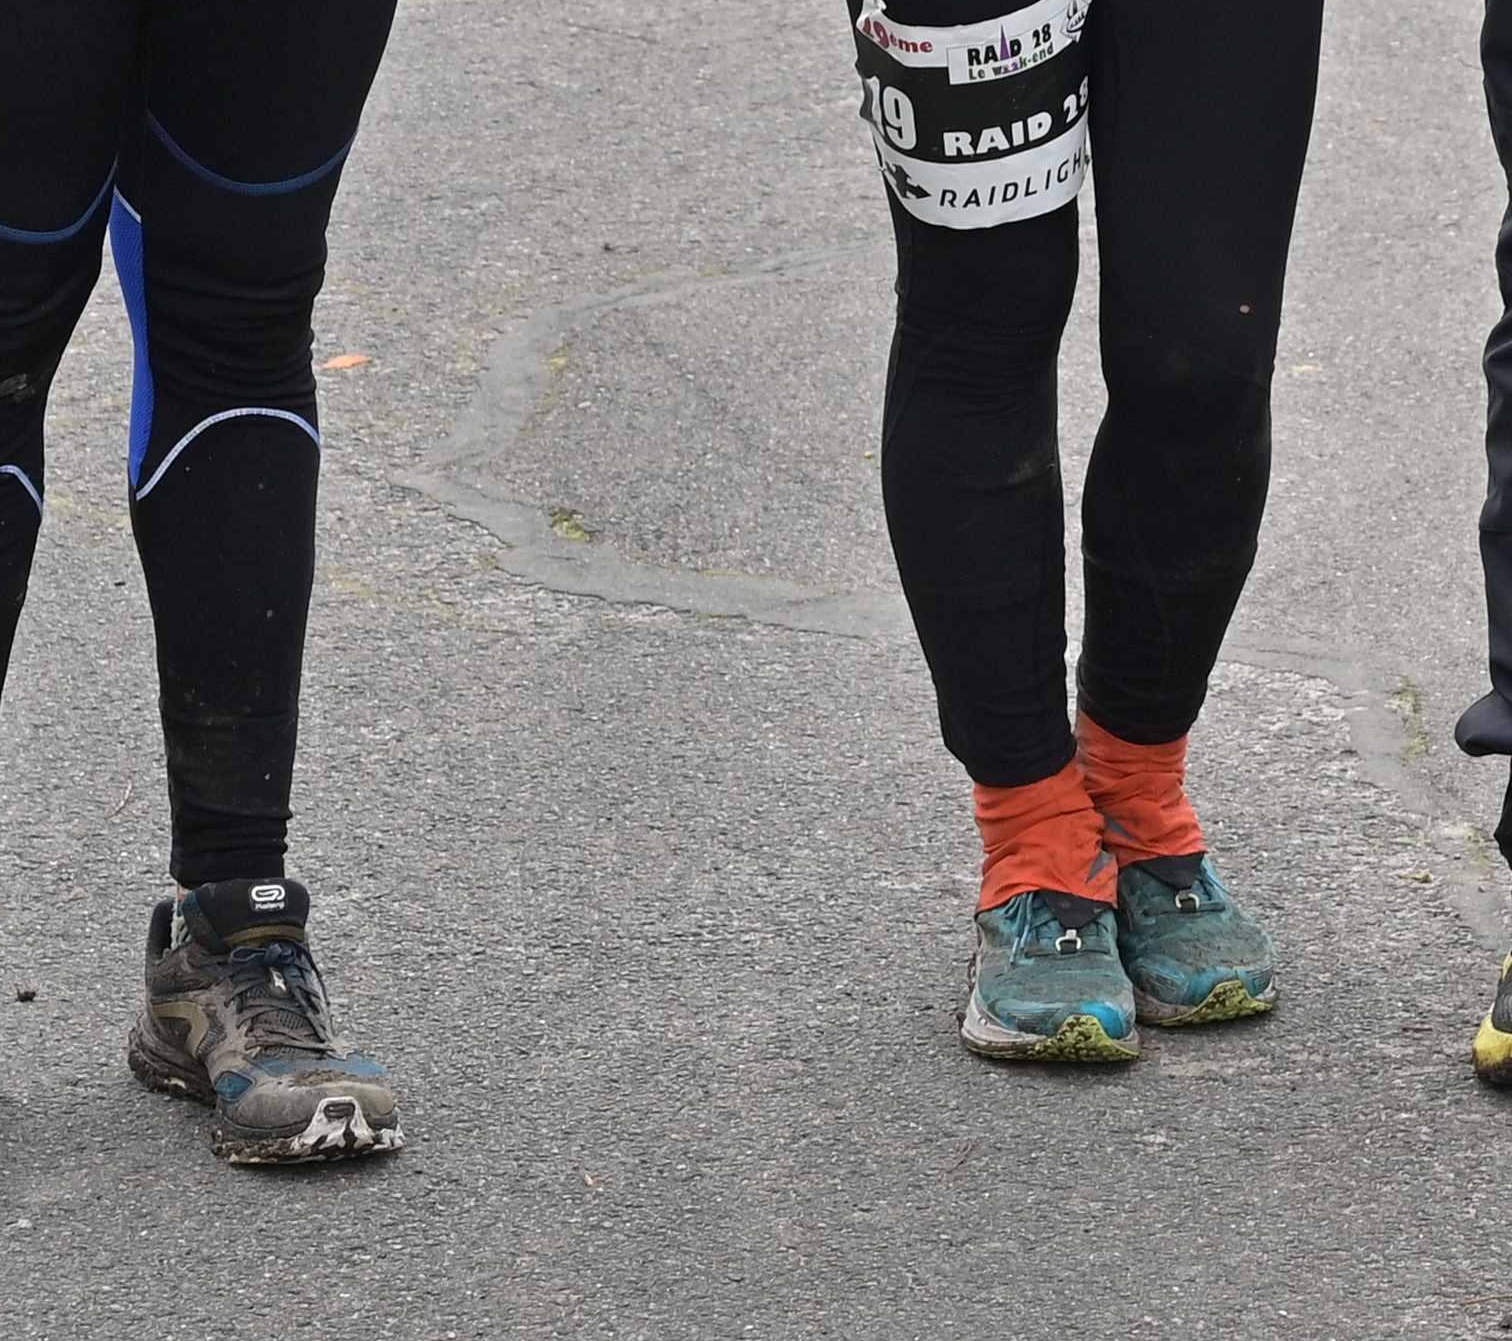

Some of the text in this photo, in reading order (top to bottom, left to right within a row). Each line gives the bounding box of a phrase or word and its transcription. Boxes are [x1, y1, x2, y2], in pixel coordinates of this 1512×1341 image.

[1032, 22, 1053, 48] 28
[943, 111, 1053, 157] RAID
[939, 148, 1091, 209] RAIDLIGH
